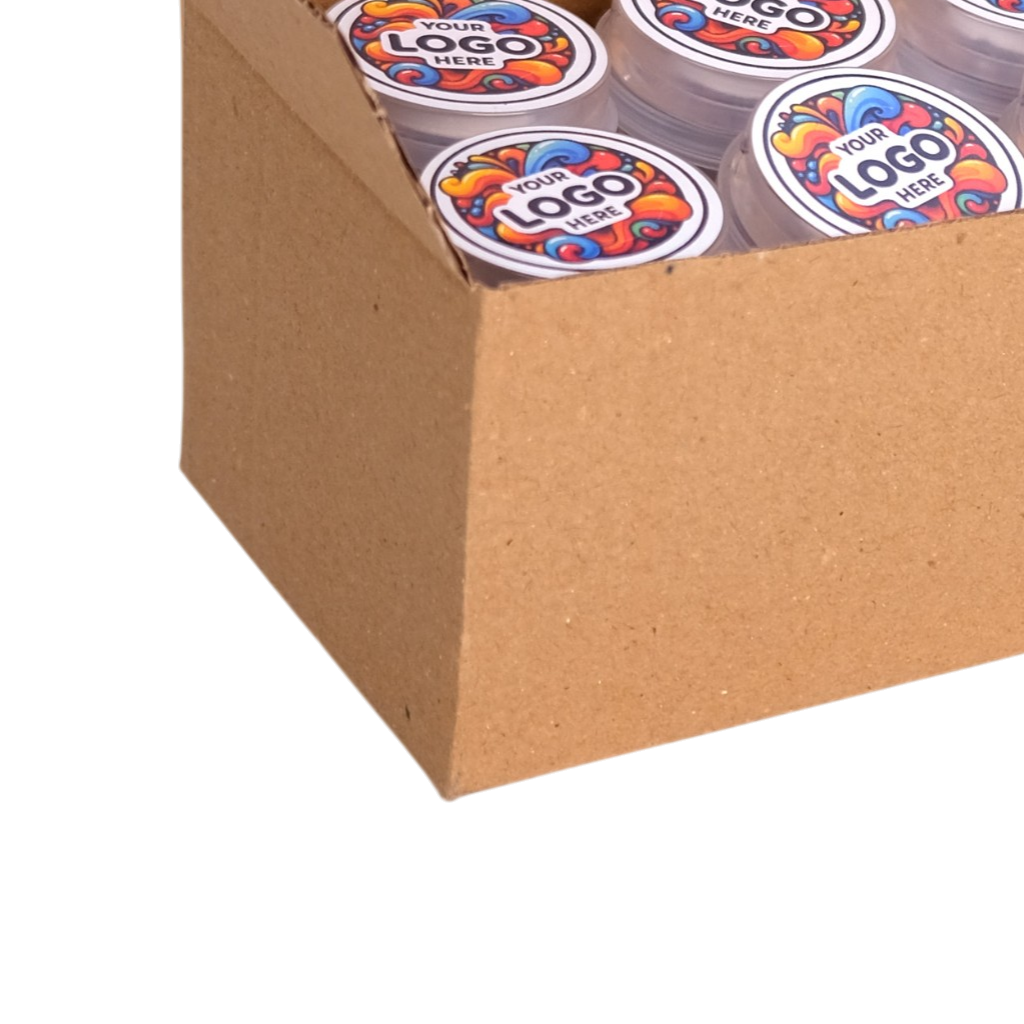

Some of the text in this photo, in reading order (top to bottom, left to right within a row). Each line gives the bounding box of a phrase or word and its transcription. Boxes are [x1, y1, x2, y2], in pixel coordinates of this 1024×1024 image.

[420, 21, 485, 31] YOUR
[713, 7, 772, 30] HERE
[388, 34, 536, 55] LOGO
[435, 56, 495, 66] HERE
[836, 128, 889, 155] YOUR
[834, 133, 950, 199] LOGO
[508, 171, 570, 194] YOUR
[895, 173, 945, 202] HERE
[500, 174, 635, 228] LOGO
[566, 206, 622, 230] HERE
